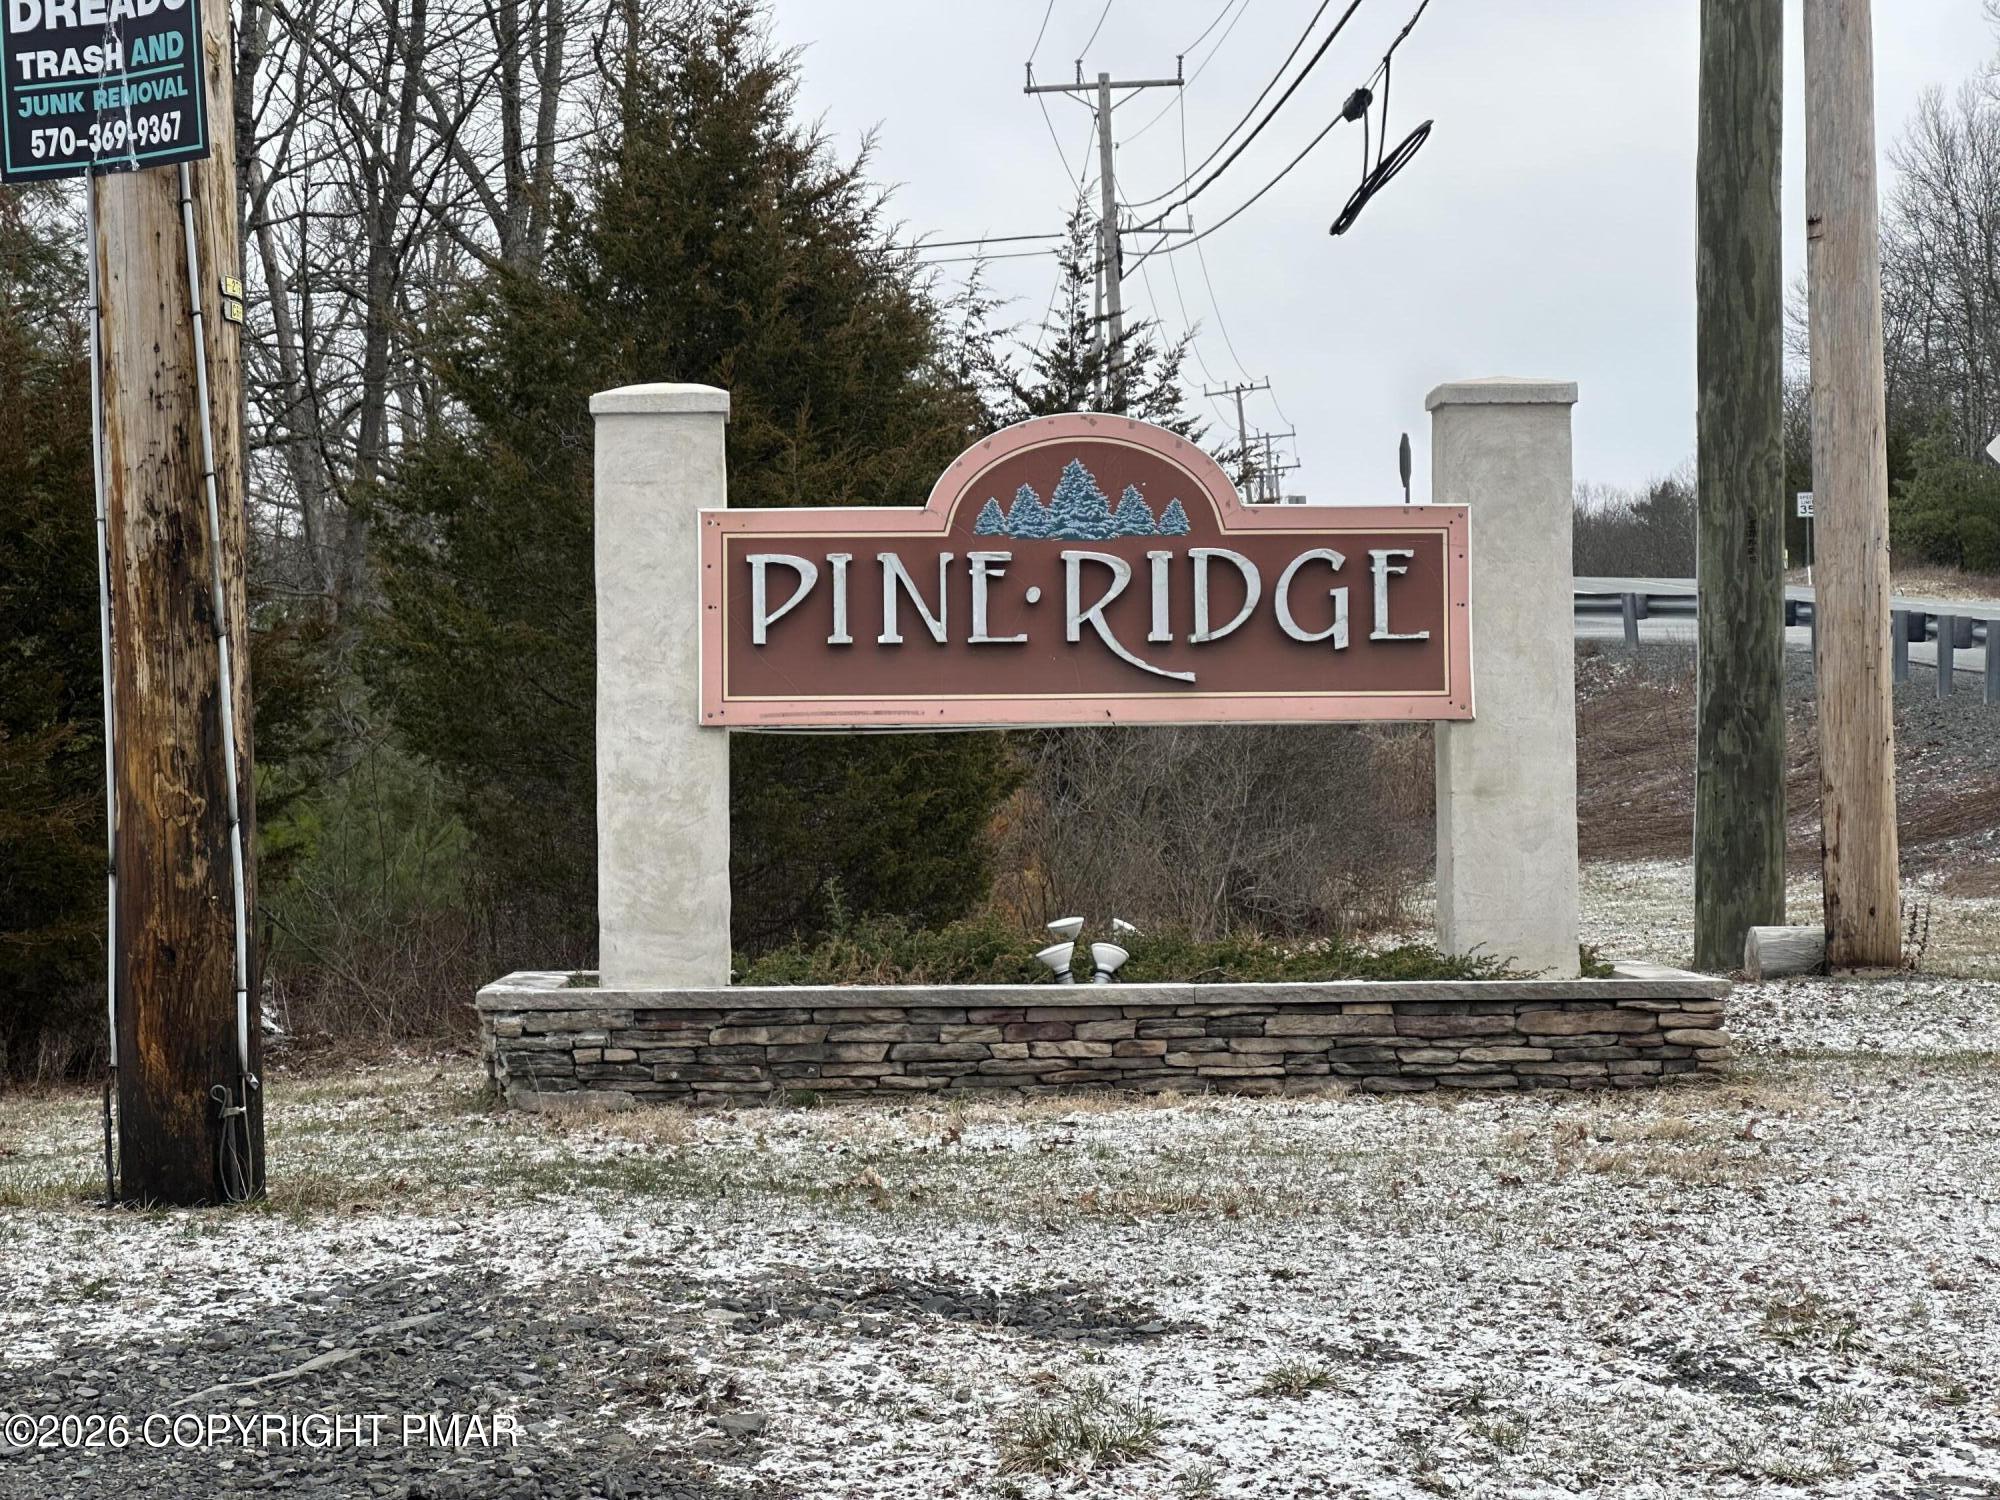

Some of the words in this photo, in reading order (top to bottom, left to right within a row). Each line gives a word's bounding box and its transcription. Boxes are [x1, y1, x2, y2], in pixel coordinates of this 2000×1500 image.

[16, 41, 123, 80] TRASH
[131, 30, 185, 67] AND
[18, 90, 85, 118] JUNK
[93, 76, 188, 111] REMOVAL
[31, 111, 181, 158] 570-369-9367
[1800, 505, 1814, 514] 35
[745, 551, 1028, 645] PINE
[1060, 547, 1430, 683] RIDGE
